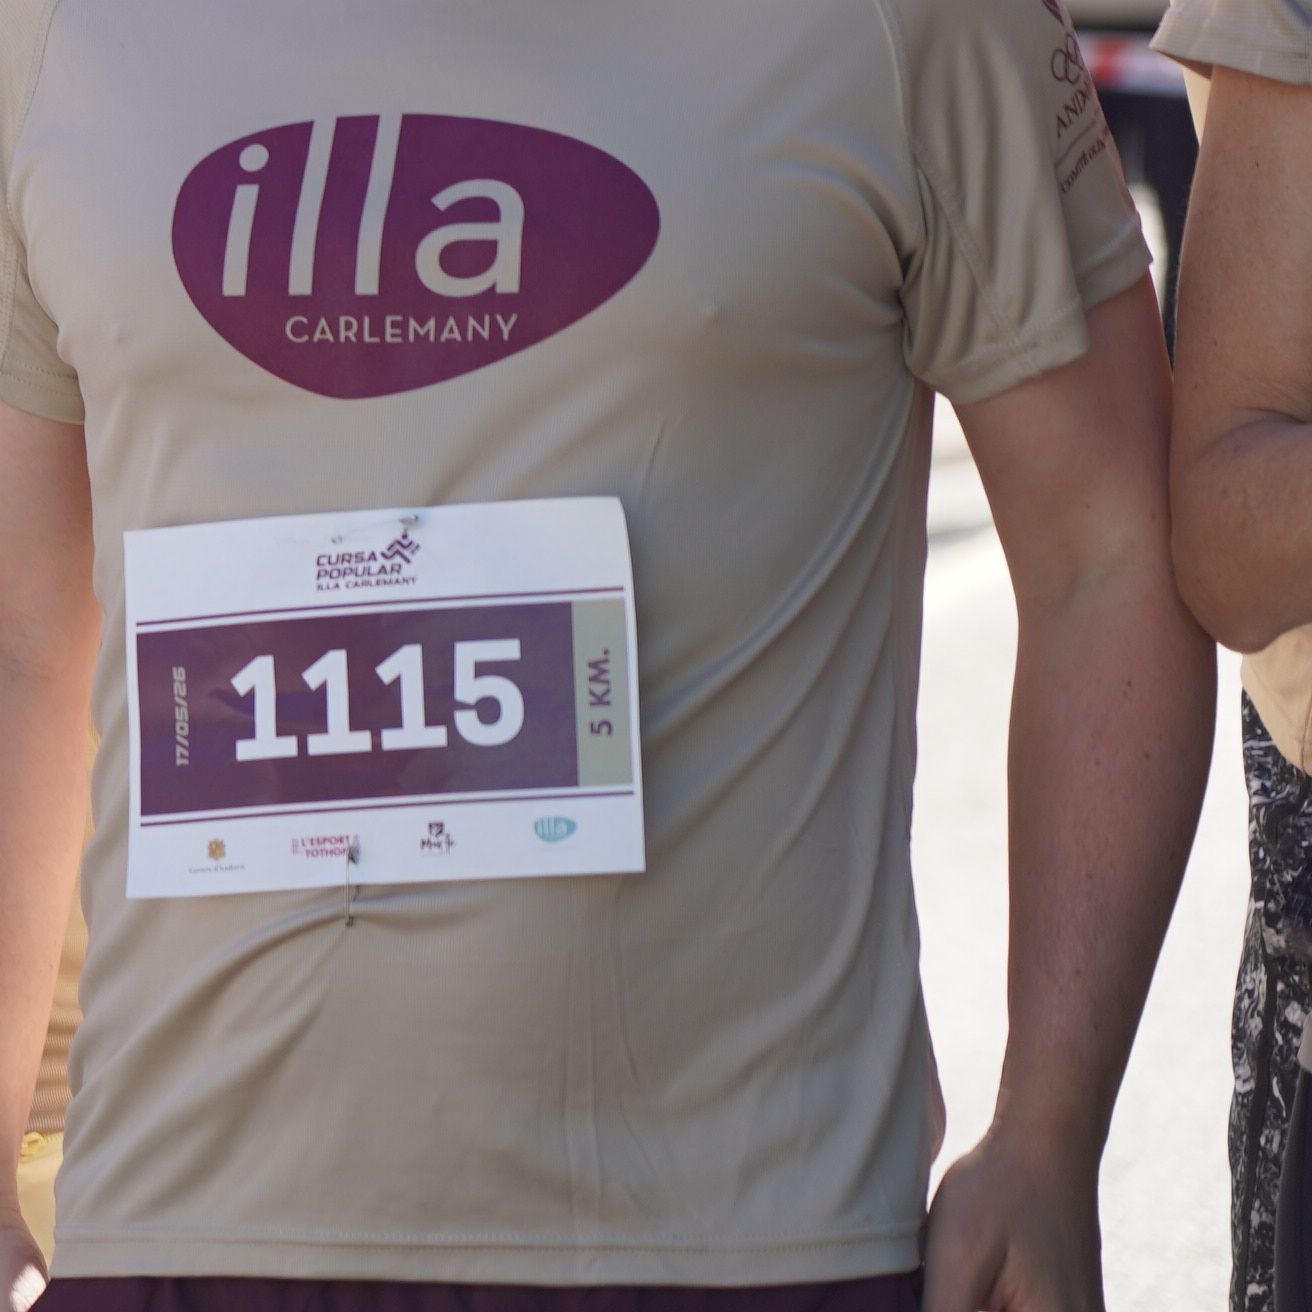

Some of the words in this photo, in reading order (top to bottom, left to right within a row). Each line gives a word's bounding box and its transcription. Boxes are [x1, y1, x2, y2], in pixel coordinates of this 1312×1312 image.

[222, 113, 526, 299] illa
[285, 313, 519, 345] CARLEMANY
[317, 551, 377, 567] CURSA
[317, 563, 402, 580] POPULAR
[229, 638, 525, 762] 1115
[588, 647, 612, 708] KM.
[173, 666, 190, 767] 17/05/26
[589, 713, 614, 738] 5
